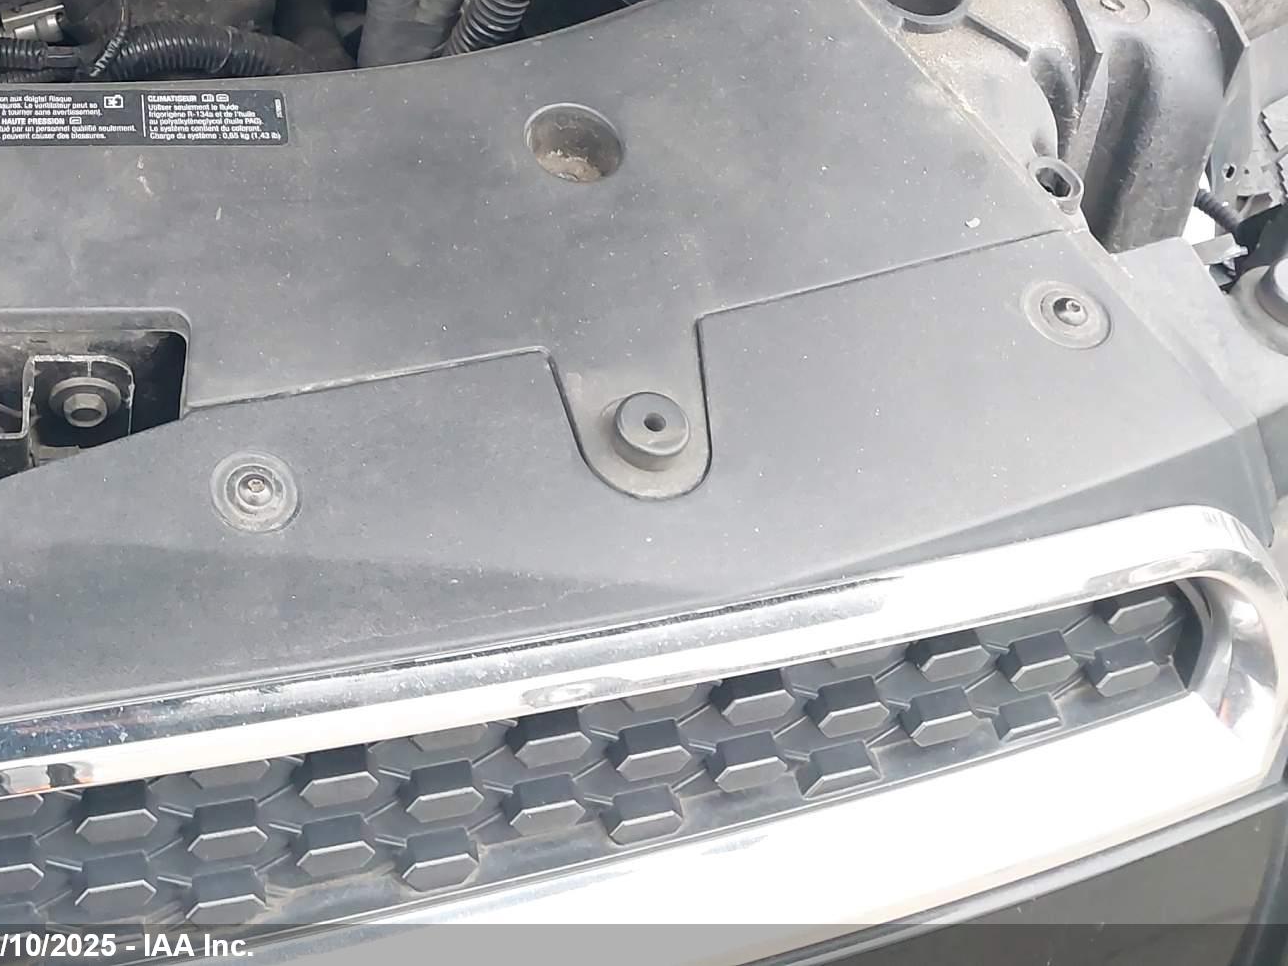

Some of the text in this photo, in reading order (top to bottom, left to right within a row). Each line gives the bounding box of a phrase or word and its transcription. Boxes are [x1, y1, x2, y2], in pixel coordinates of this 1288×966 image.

[148, 111, 186, 119] frigorigène
[1, 117, 27, 125] HAUTE
[27, 117, 65, 125] PRESSION
[11, 125, 24, 133] par
[35, 125, 70, 133] personnel
[71, 125, 97, 133] qualifié
[270, 132, 281, 140] lb)
